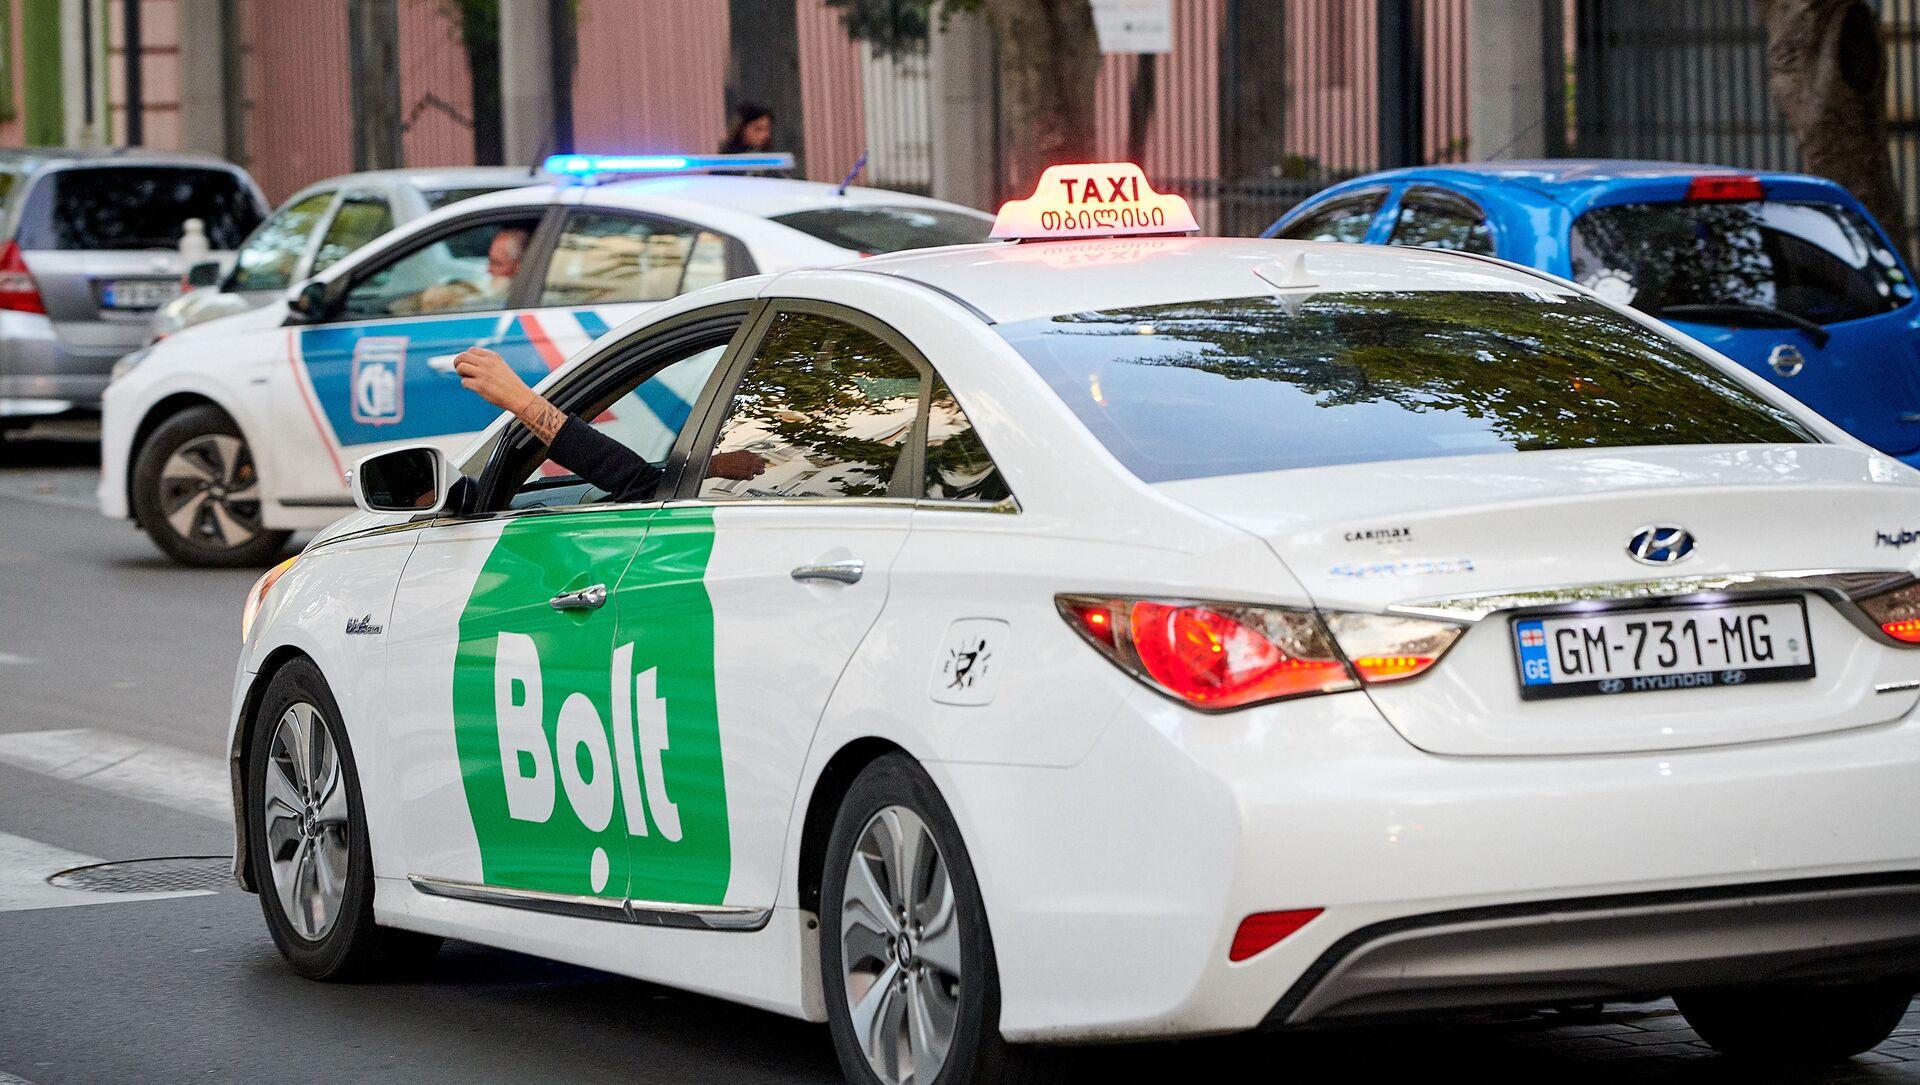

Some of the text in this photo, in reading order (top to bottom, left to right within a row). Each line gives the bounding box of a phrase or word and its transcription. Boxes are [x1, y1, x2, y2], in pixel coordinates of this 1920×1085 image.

[1060, 176, 1140, 204] TAXI
[1041, 206, 1165, 231] თბილისი
[1555, 613, 1774, 676] GM-731-MG
[1525, 658, 1550, 680] GE
[494, 631, 684, 893] Bolt
